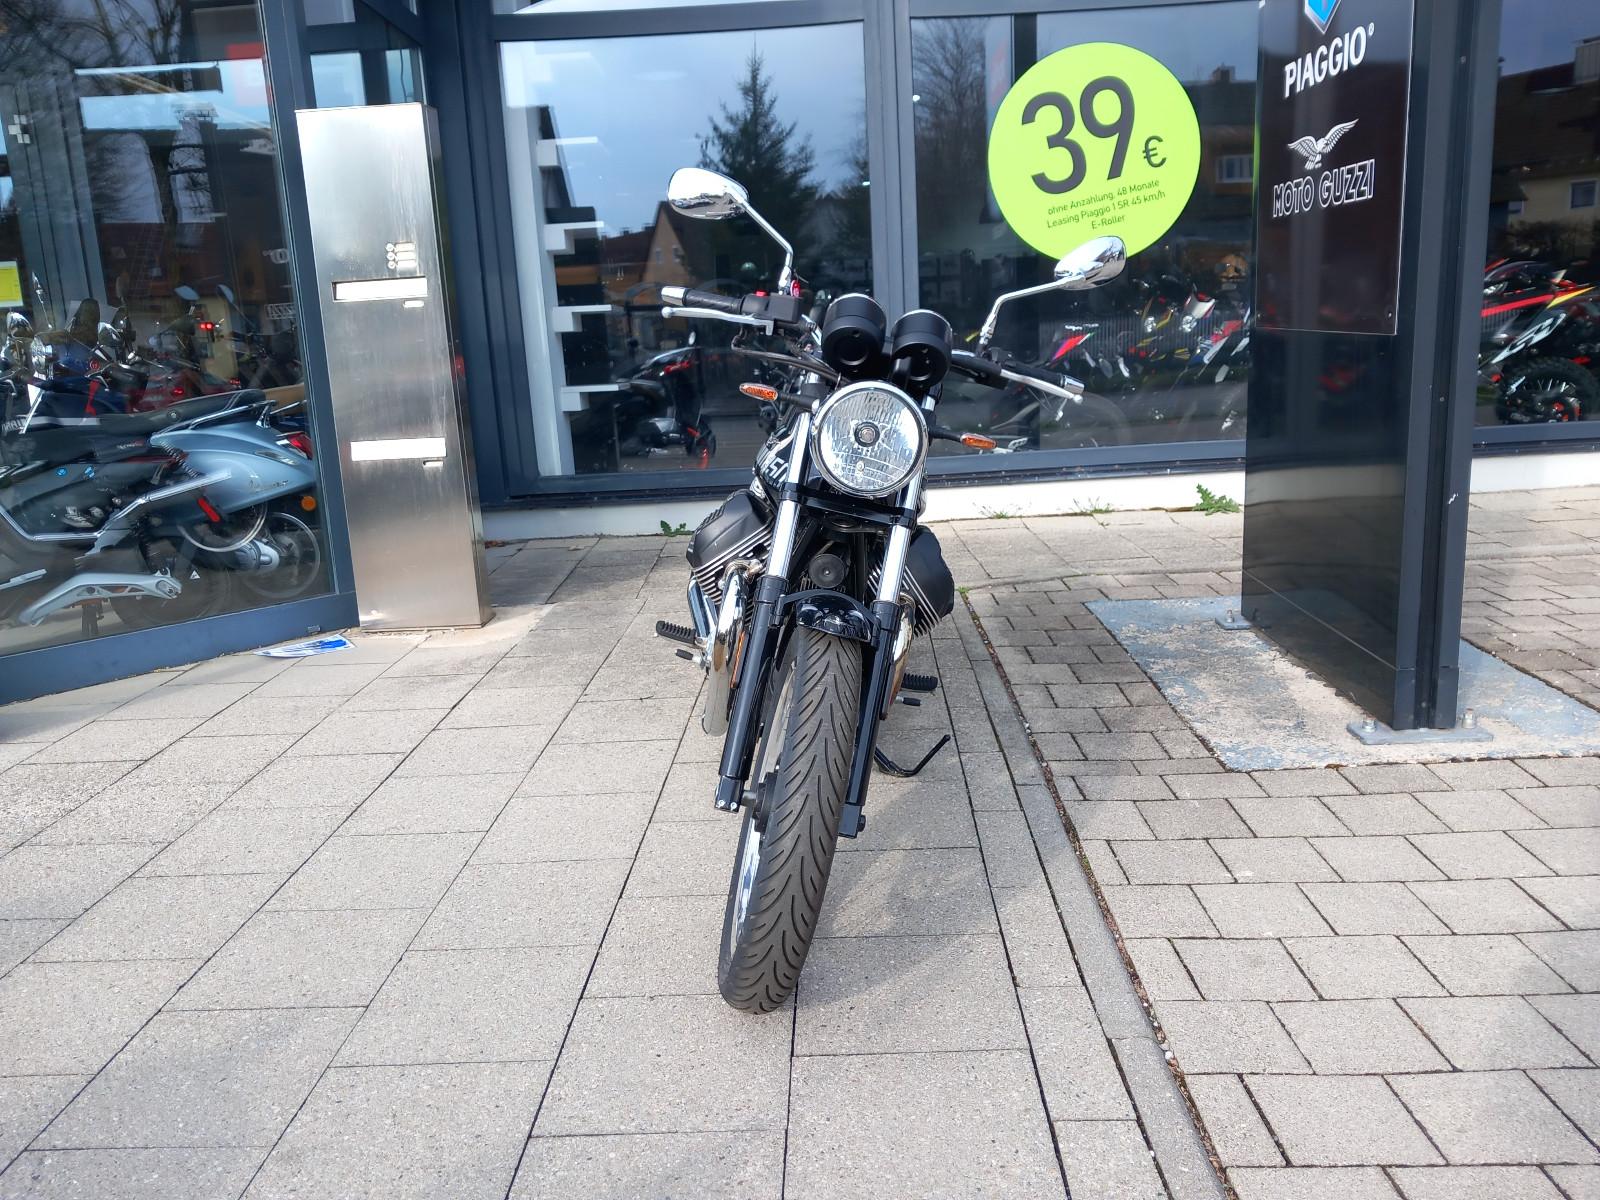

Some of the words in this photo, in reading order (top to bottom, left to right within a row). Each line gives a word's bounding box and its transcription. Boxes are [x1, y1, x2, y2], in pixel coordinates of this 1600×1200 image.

[1021, 75, 1136, 195] 39
[1142, 135, 1167, 168] €
[1048, 205, 1068, 215] ohne
[1117, 186, 1128, 197] 48
[1129, 180, 1159, 193] Monate
[1272, 175, 1315, 218] MOTO
[1318, 159, 1375, 208] GUZZI
[1047, 214, 1080, 228] Leasing
[1081, 206, 1111, 220] Piaggio
[1118, 199, 1130, 210] SR
[1131, 196, 1142, 206] 45
[1143, 191, 1165, 203] km/h
[1091, 215, 1125, 229] E-Roller
